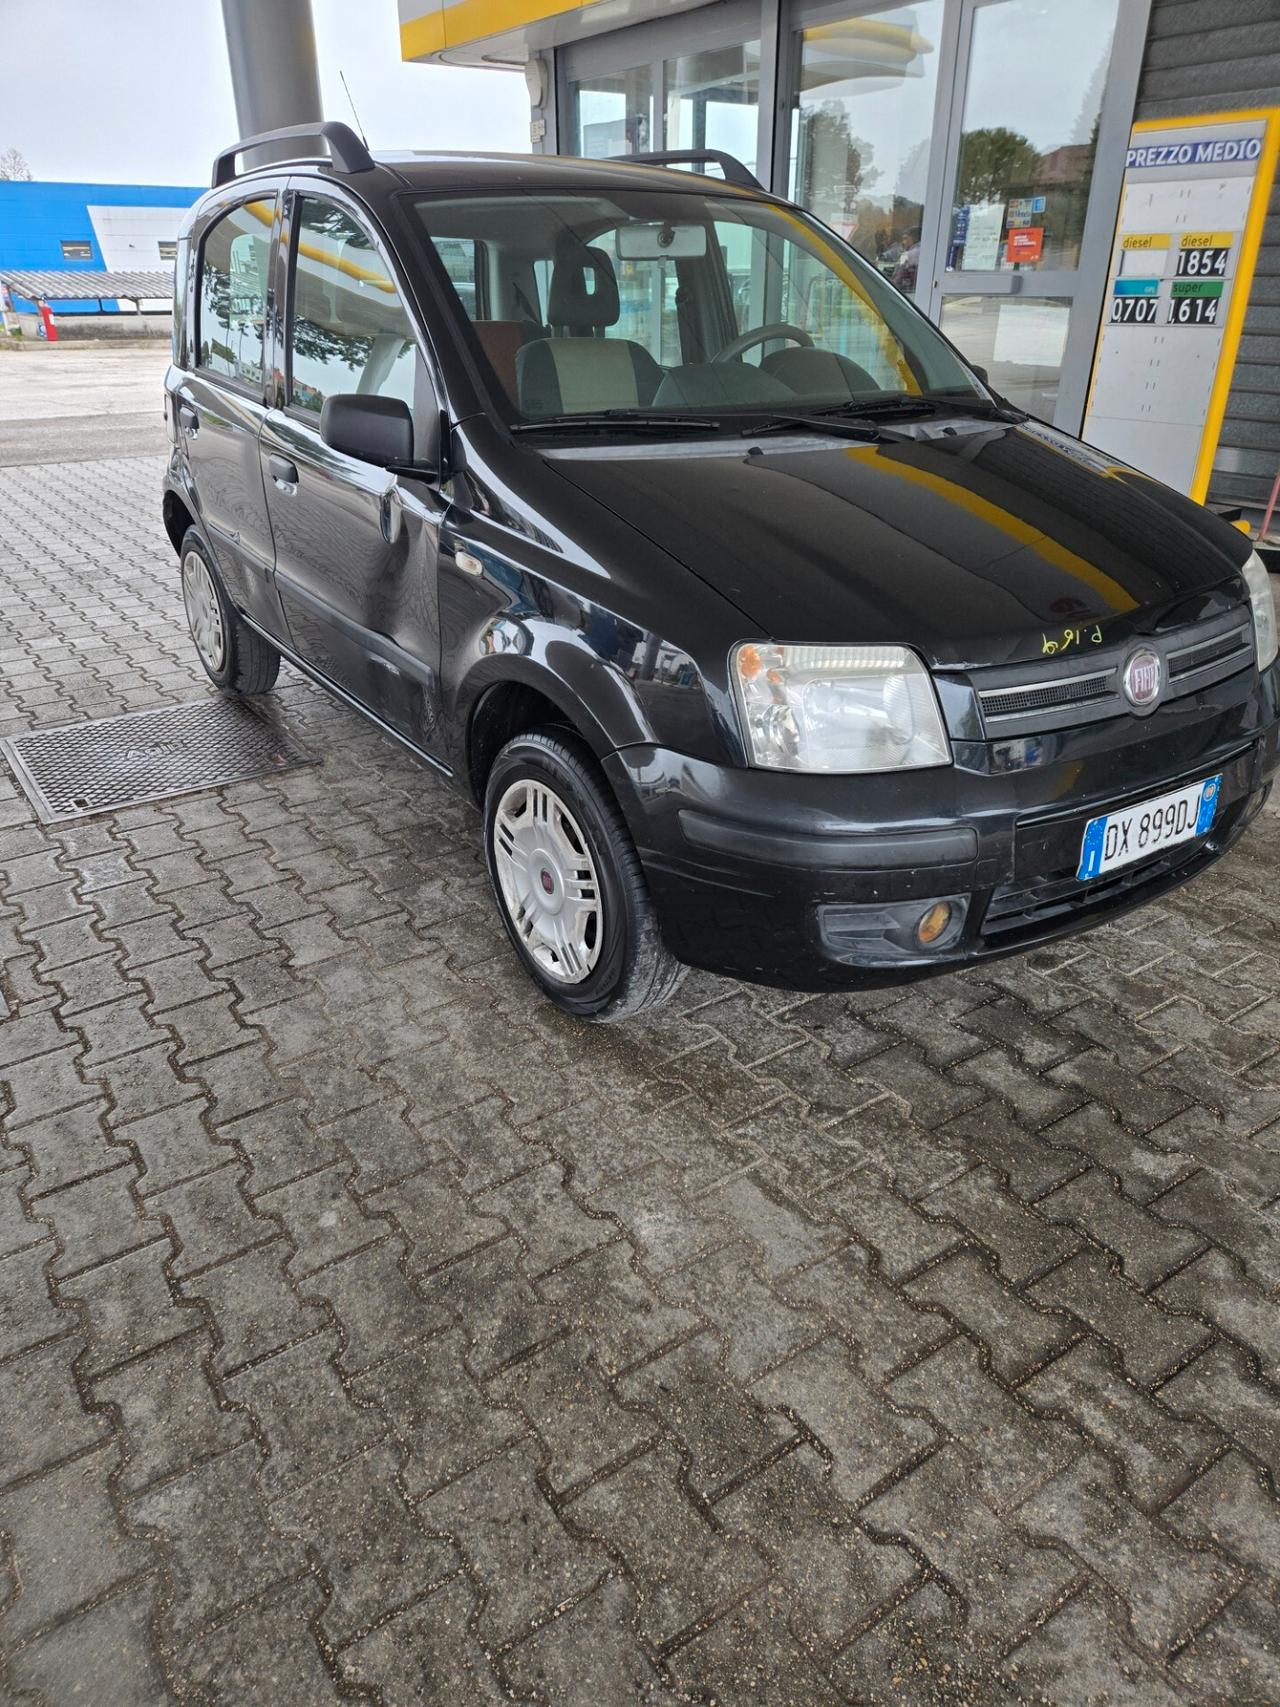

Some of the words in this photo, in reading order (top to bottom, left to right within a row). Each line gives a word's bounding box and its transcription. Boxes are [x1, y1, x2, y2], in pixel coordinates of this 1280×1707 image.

[1125, 145, 1192, 167] PREZZO
[1195, 138, 1262, 163] MEDIO
[1122, 236, 1153, 249] diesel
[1180, 234, 1213, 248] diesel
[1172, 283, 1204, 296] super
[1134, 662, 1155, 693] FIAT
[1103, 817, 1133, 862] DX
[1138, 792, 1202, 849] 899DJ
